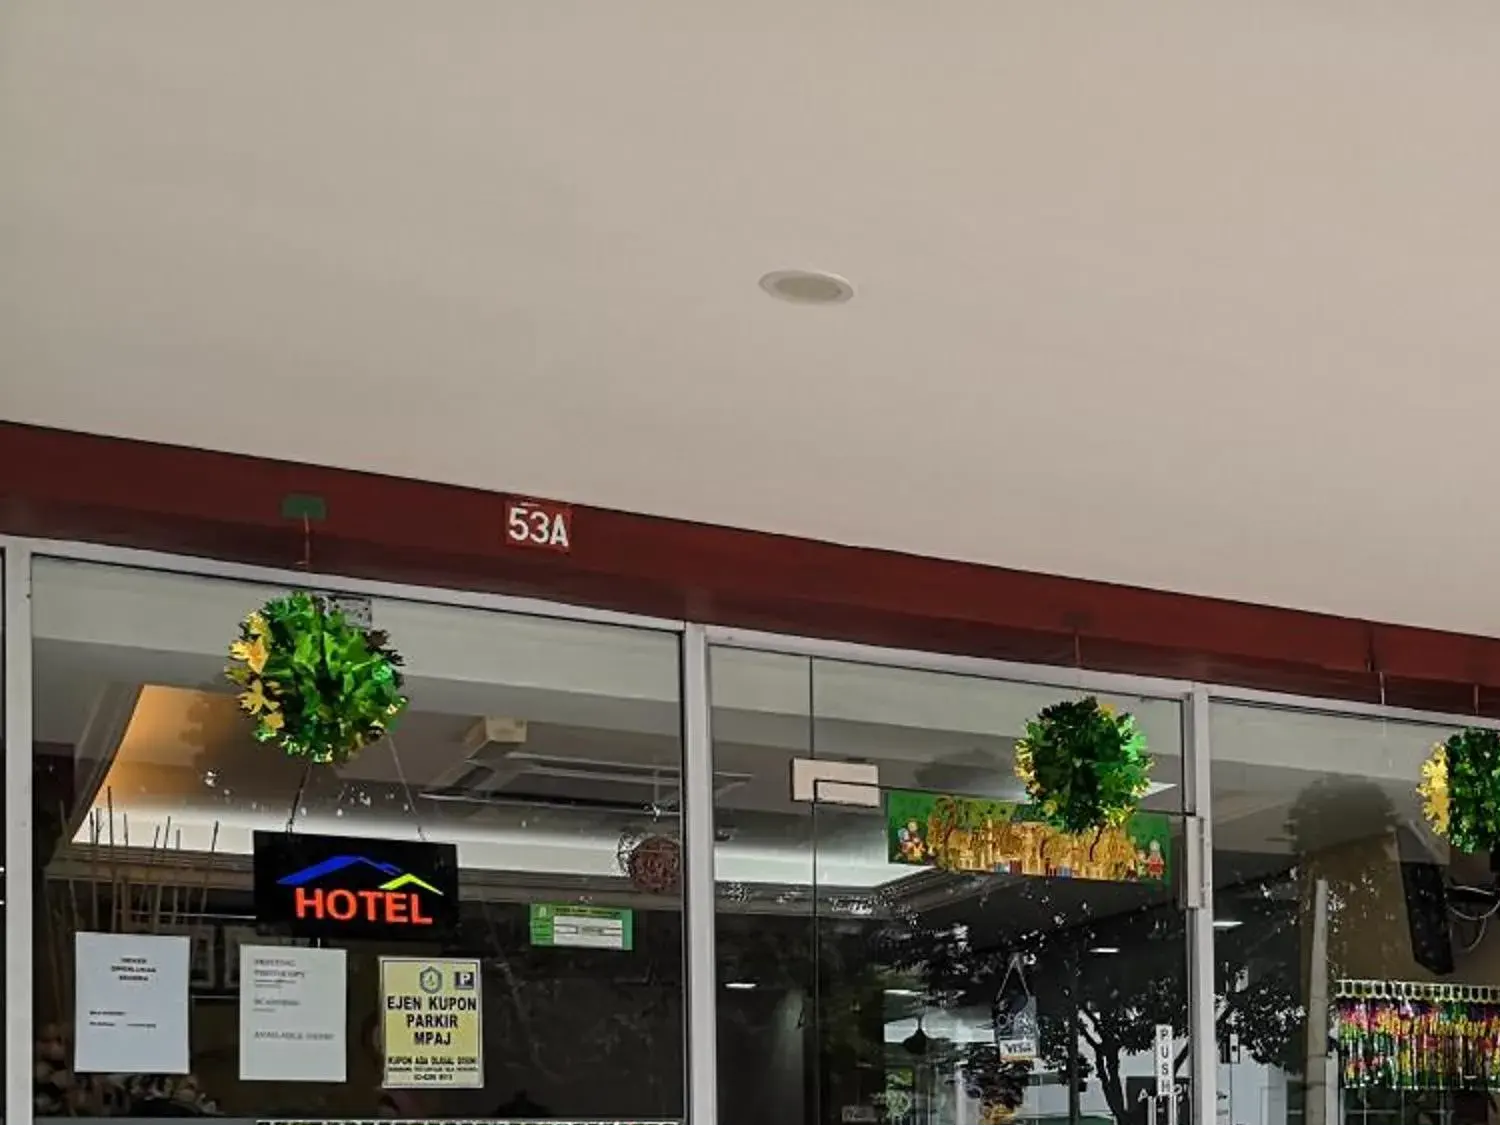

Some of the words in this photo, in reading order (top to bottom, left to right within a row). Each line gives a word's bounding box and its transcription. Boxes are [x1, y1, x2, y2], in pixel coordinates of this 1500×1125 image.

[508, 507, 569, 547] 53A
[295, 887, 434, 925] HOTEL
[387, 996, 422, 1010] EJEN
[428, 997, 477, 1011] KUPON
[406, 1013, 459, 1028] PARKIR
[413, 1031, 451, 1045] MPAJ
[1160, 1027, 1171, 1093] PUSH
